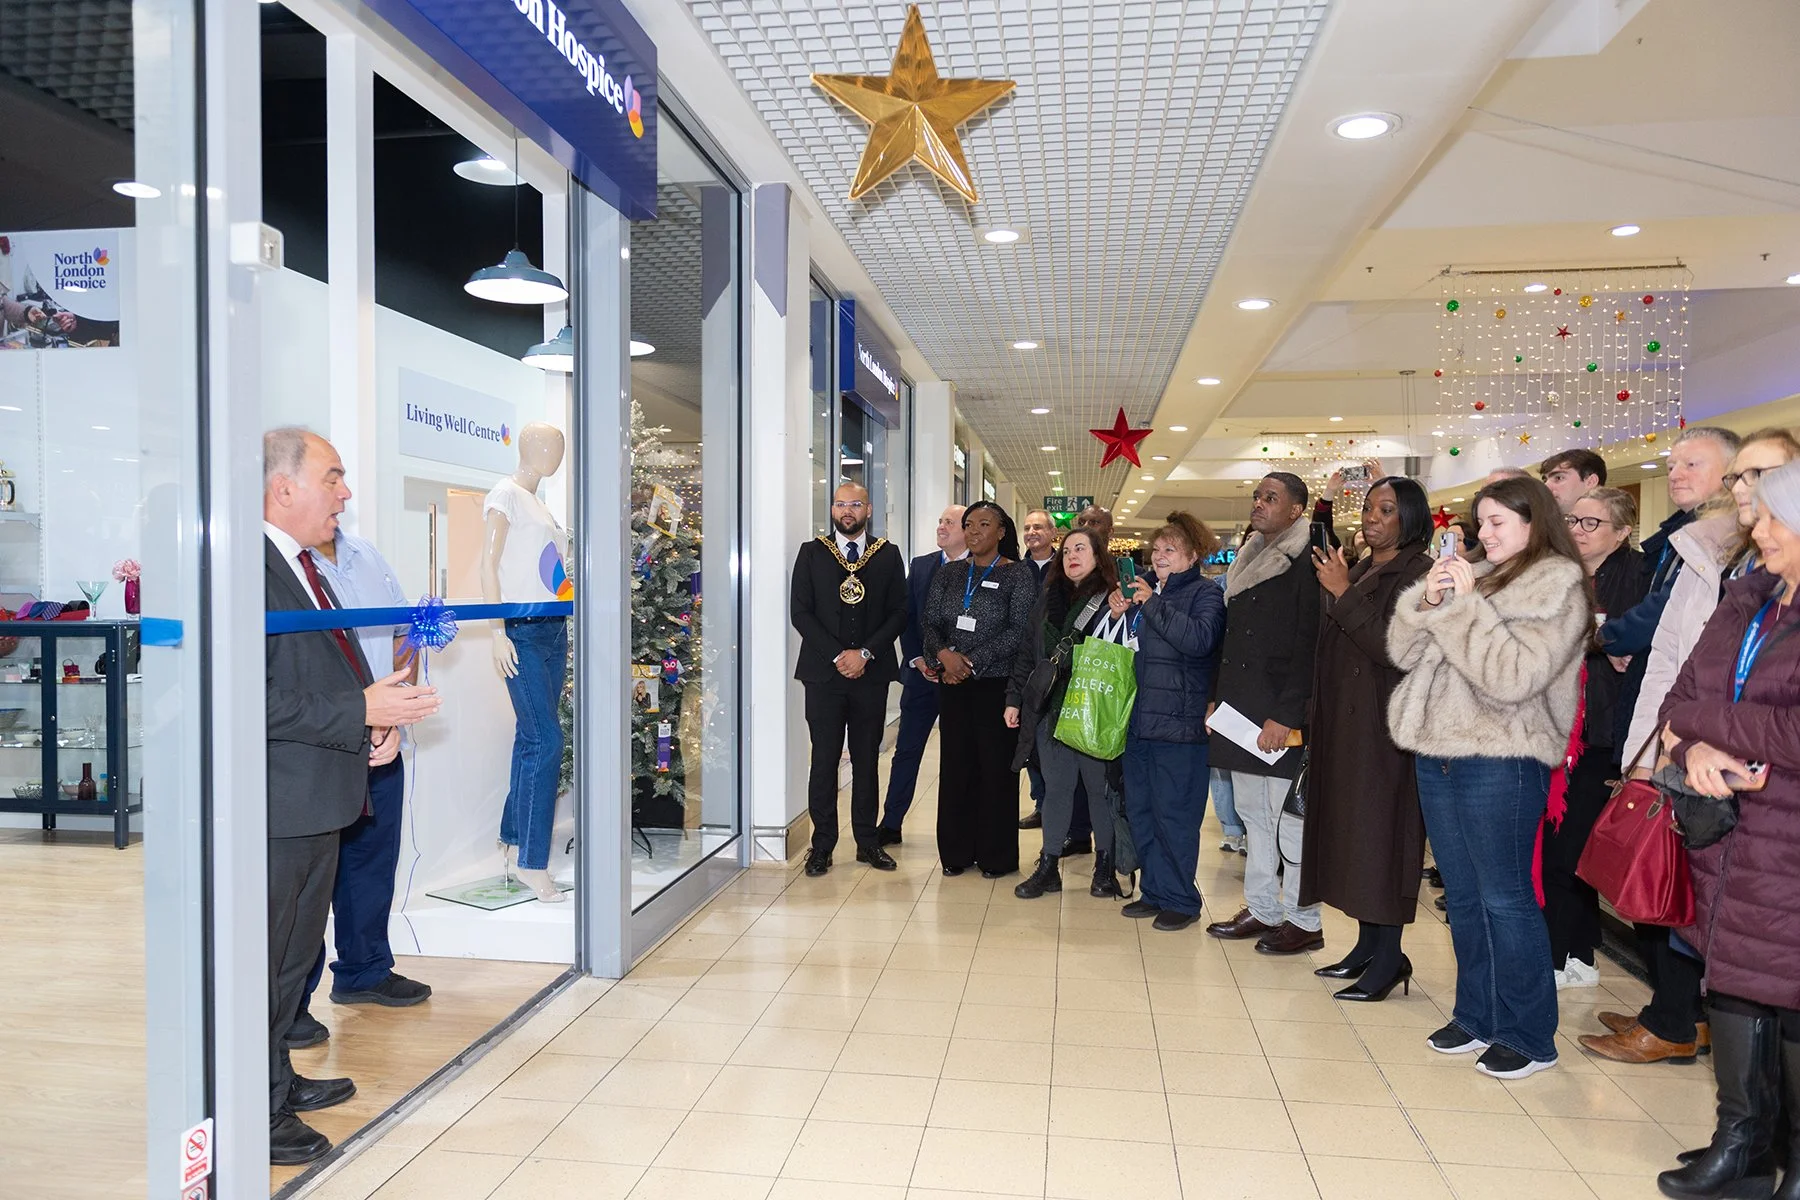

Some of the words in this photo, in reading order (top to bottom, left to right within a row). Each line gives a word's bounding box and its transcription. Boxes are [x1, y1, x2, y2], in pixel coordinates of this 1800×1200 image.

[546, 0, 624, 115] Hospice
[54, 252, 93, 265] North
[55, 264, 105, 278] London
[55, 277, 106, 290] Hospice
[406, 402, 443, 432] Living
[444, 413, 467, 434] Well
[468, 420, 501, 442] Centre
[1046, 497, 1063, 505] Fire
